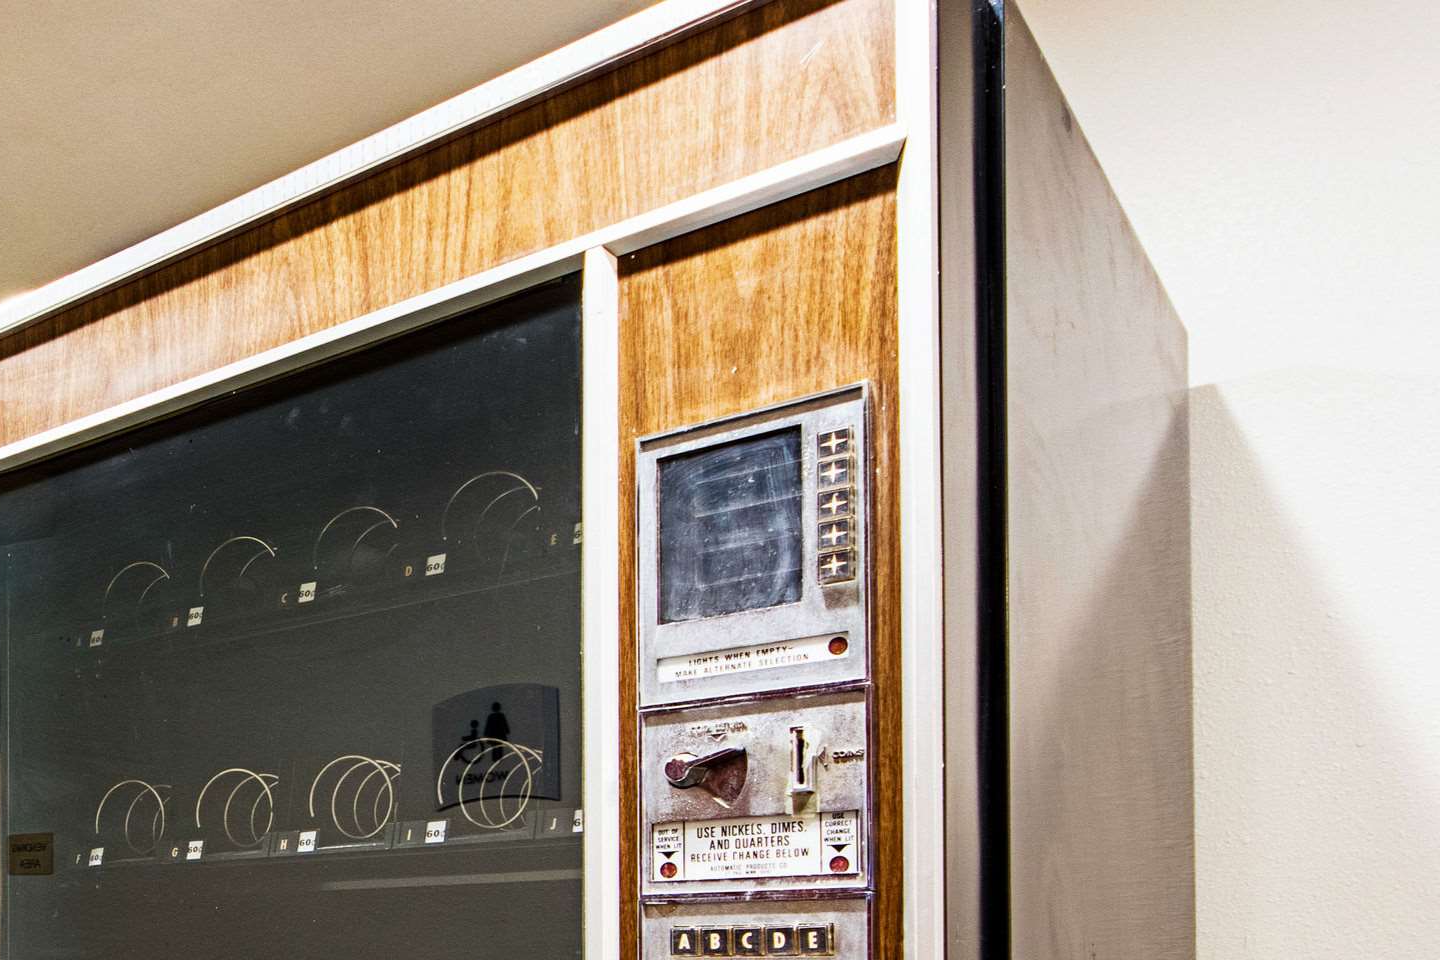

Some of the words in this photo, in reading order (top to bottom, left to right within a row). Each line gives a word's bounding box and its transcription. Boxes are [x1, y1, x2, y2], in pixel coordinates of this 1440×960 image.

[405, 566, 412, 576] D
[675, 669, 697, 678] MAKE
[704, 661, 752, 673] ALTERNATE
[760, 654, 809, 665] SELECTION
[688, 656, 718, 667] LIGHTS
[724, 652, 750, 661] WHEN
[550, 818, 557, 830] J
[697, 826, 716, 838] USE
[710, 838, 729, 850] AND
[735, 835, 790, 849] QUARTERS
[691, 852, 727, 863] RECEIVE
[733, 850, 770, 860] CHANGE
[776, 848, 809, 858] BELOW
[678, 933, 691, 950] A
[709, 933, 721, 950] B
[742, 932, 753, 949] C
[773, 932, 786, 948] D
[809, 931, 818, 949] E
